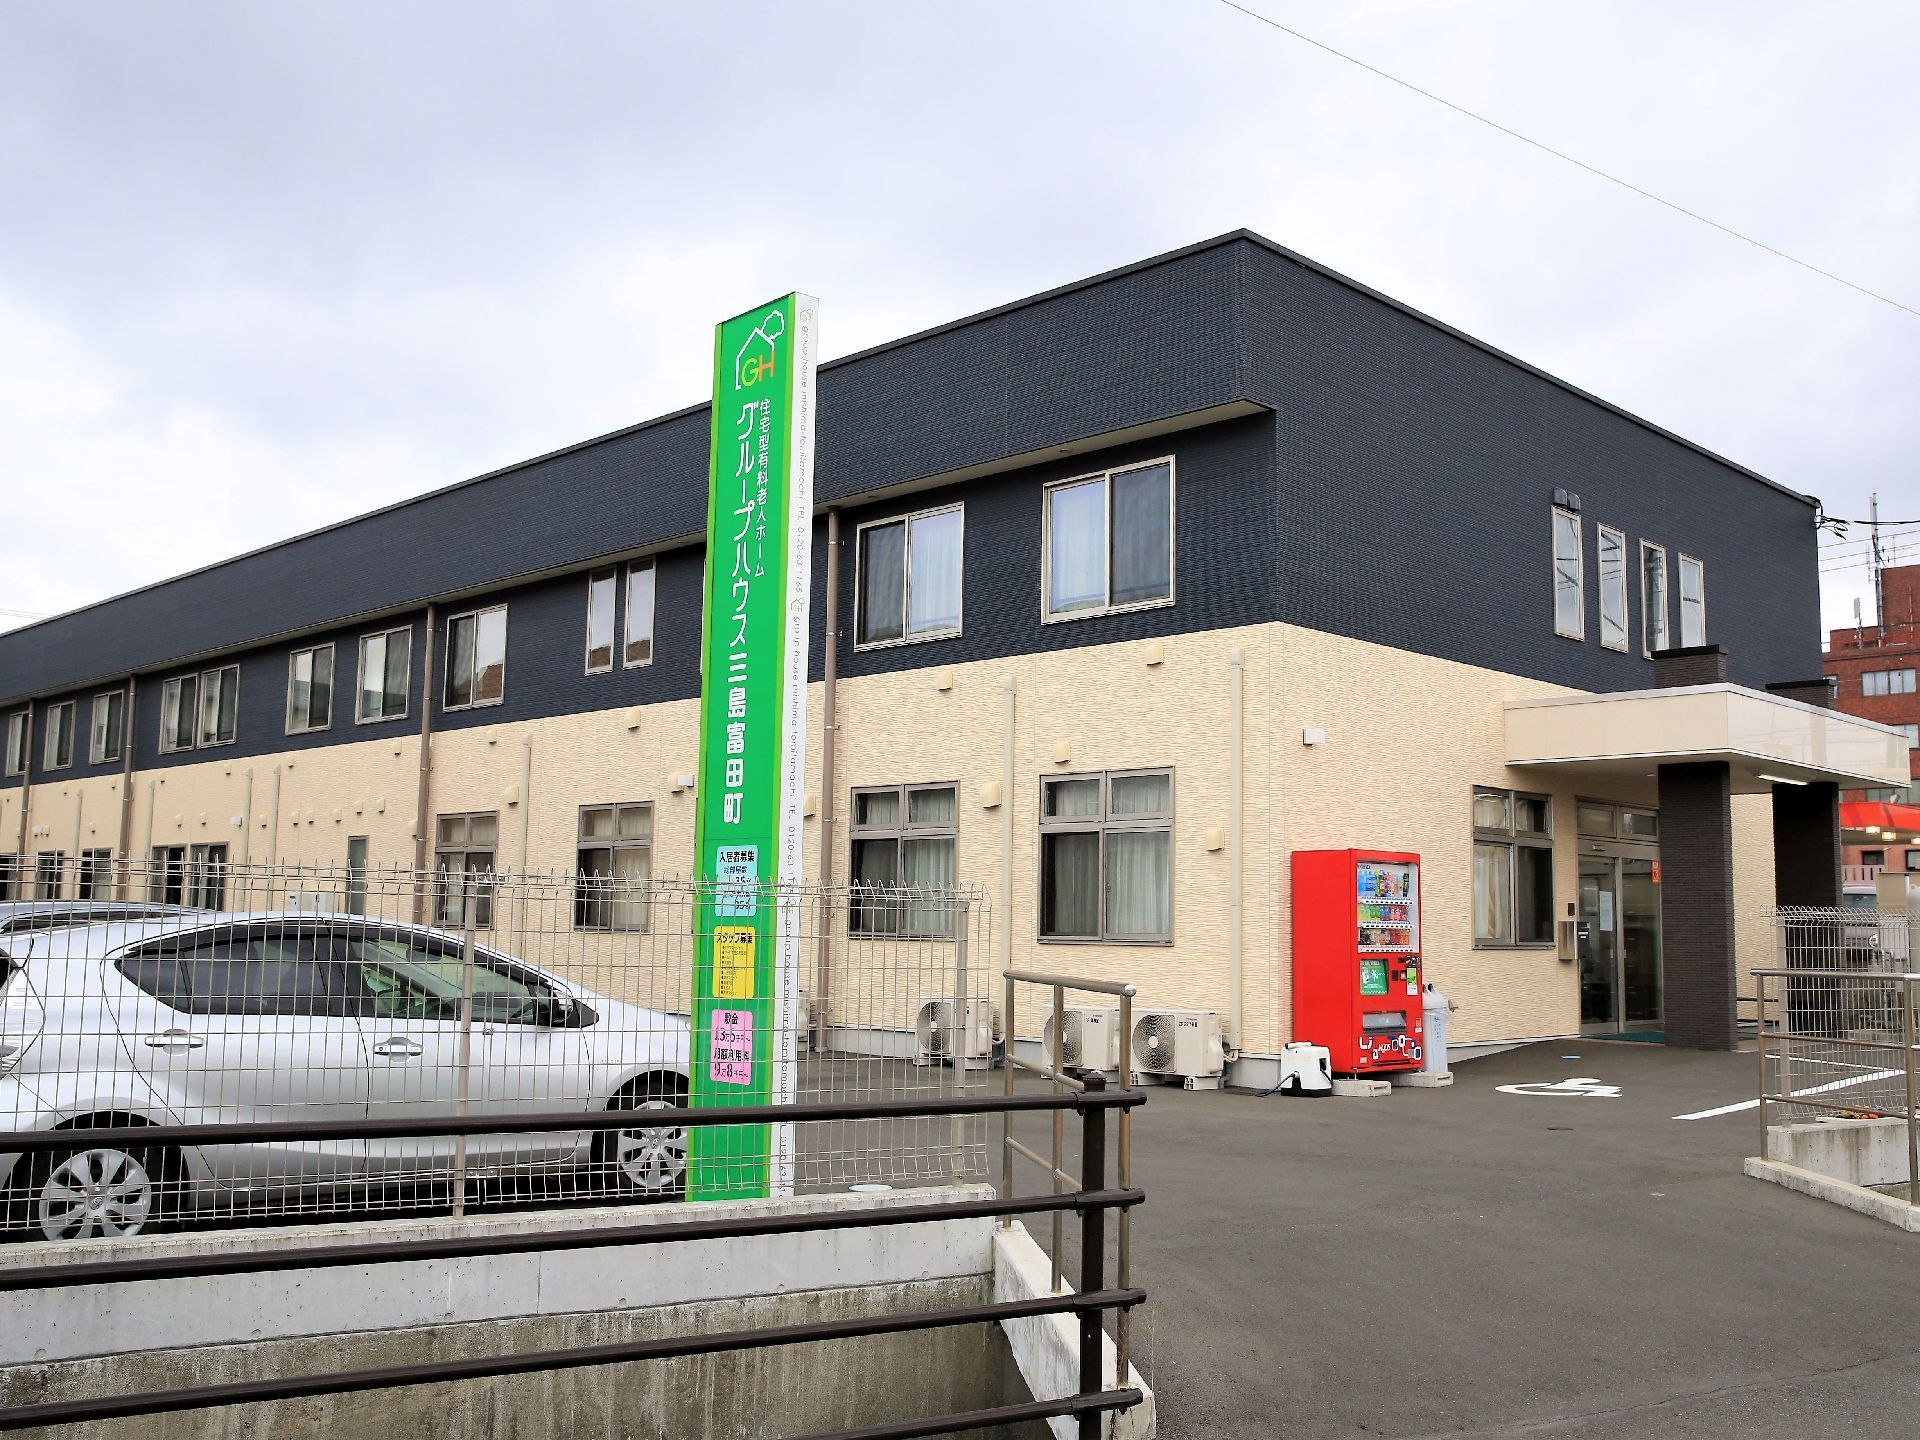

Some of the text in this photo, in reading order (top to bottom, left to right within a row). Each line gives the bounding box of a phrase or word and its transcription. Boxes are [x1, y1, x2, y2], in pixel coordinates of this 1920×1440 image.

[741, 350, 775, 387] GH
[754, 398, 771, 577] 住宅型有料老人ホーム
[719, 850, 755, 863] 入居者募集
